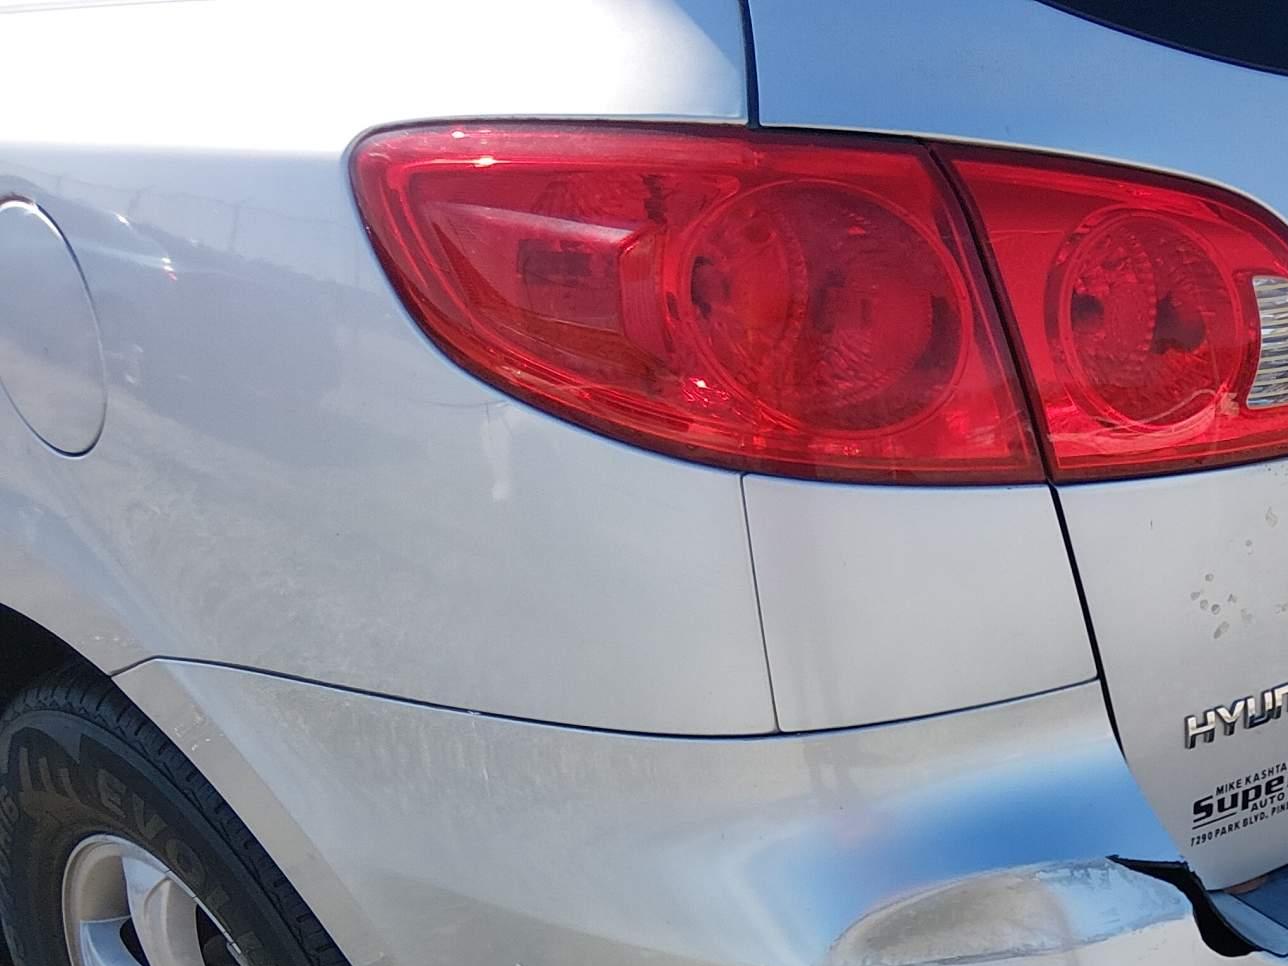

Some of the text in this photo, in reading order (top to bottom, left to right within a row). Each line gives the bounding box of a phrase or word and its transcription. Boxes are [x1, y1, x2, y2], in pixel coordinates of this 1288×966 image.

[1216, 779, 1242, 796] MIKE
[1251, 792, 1285, 812] AUTO
[1190, 831, 1213, 847] 7290
[1214, 822, 1241, 838] PARK
[1242, 811, 1269, 828] BLVD.
